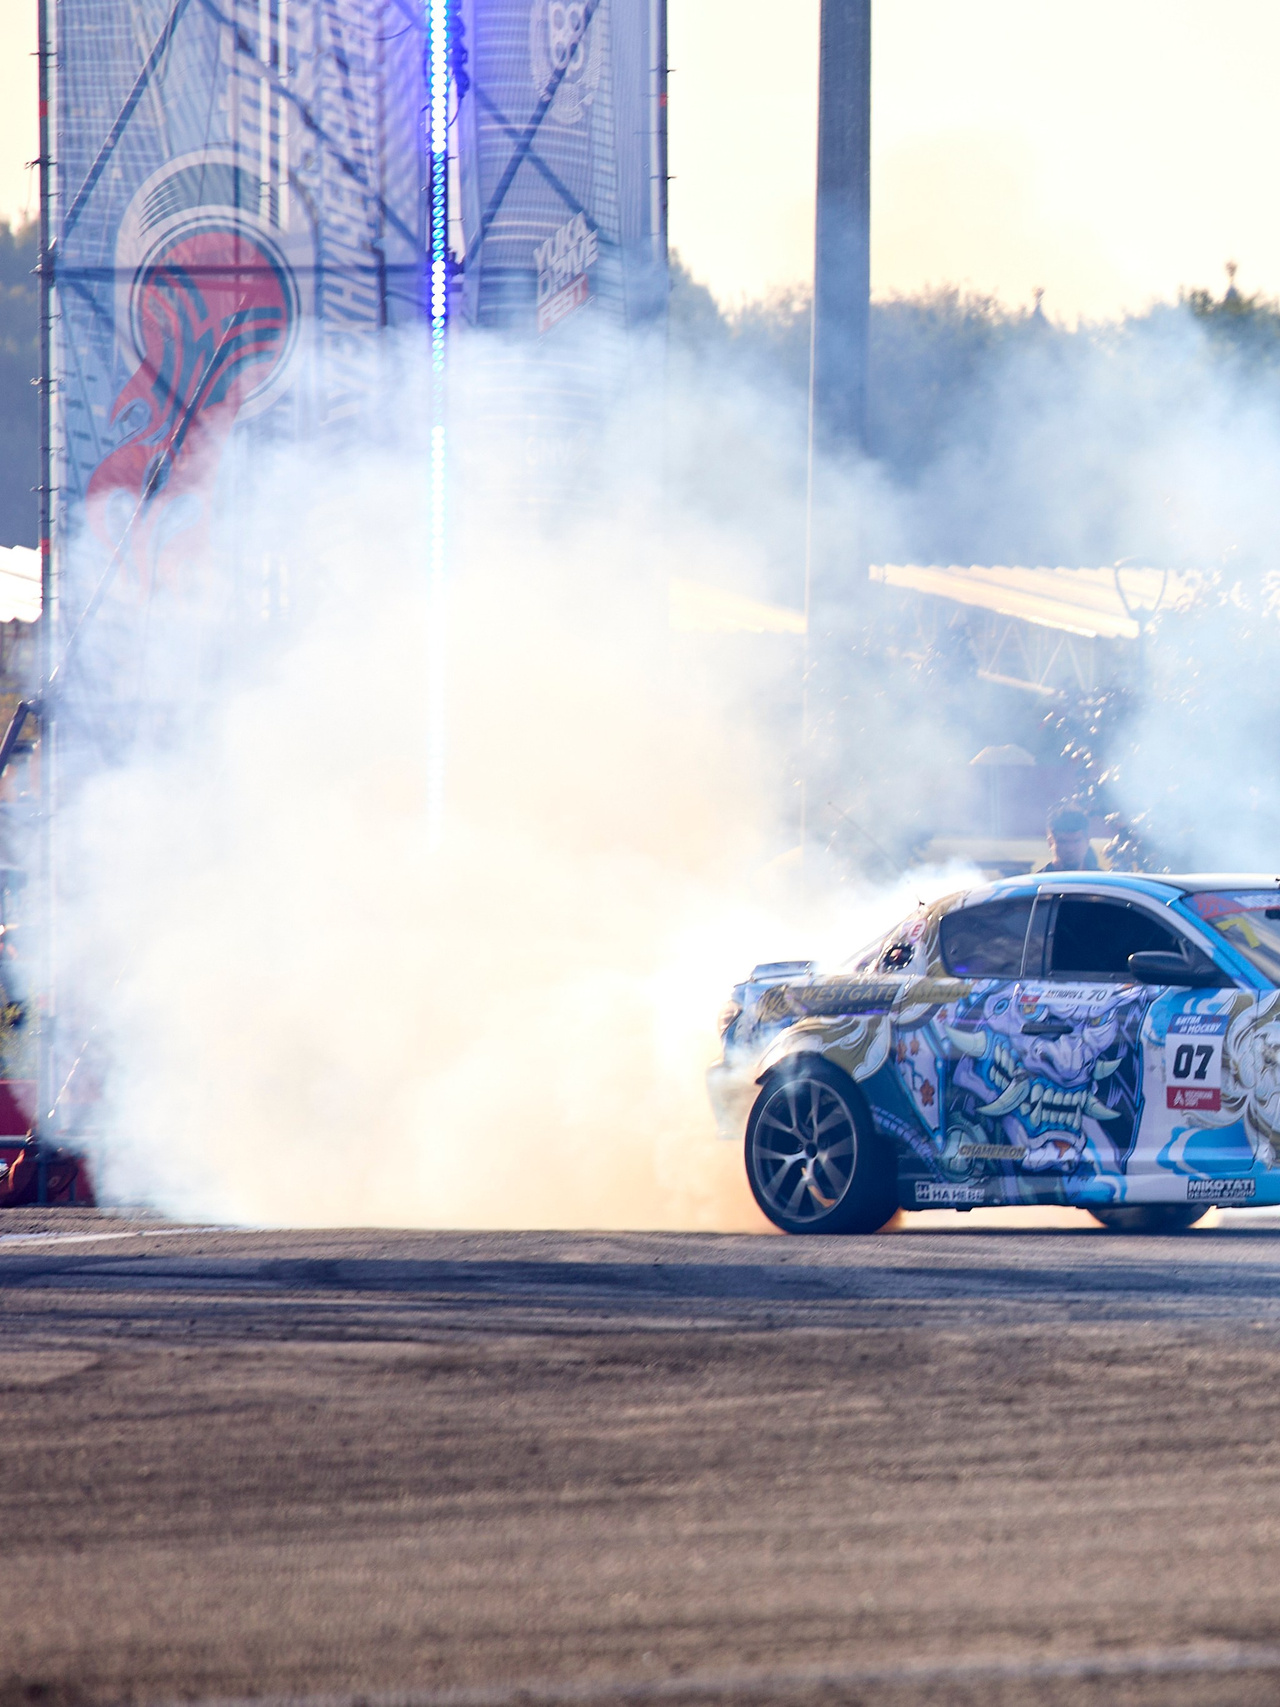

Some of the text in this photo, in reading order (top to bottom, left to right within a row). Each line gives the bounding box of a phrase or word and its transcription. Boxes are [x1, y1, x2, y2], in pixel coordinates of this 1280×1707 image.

[533, 211, 592, 277] YUKA
[537, 229, 598, 307] DRIVE
[538, 273, 586, 333] FEST
[803, 985, 896, 1001] WESTGATE
[1173, 1043, 1214, 1080] 07
[1188, 1180, 1255, 1191] MIKOTATI
